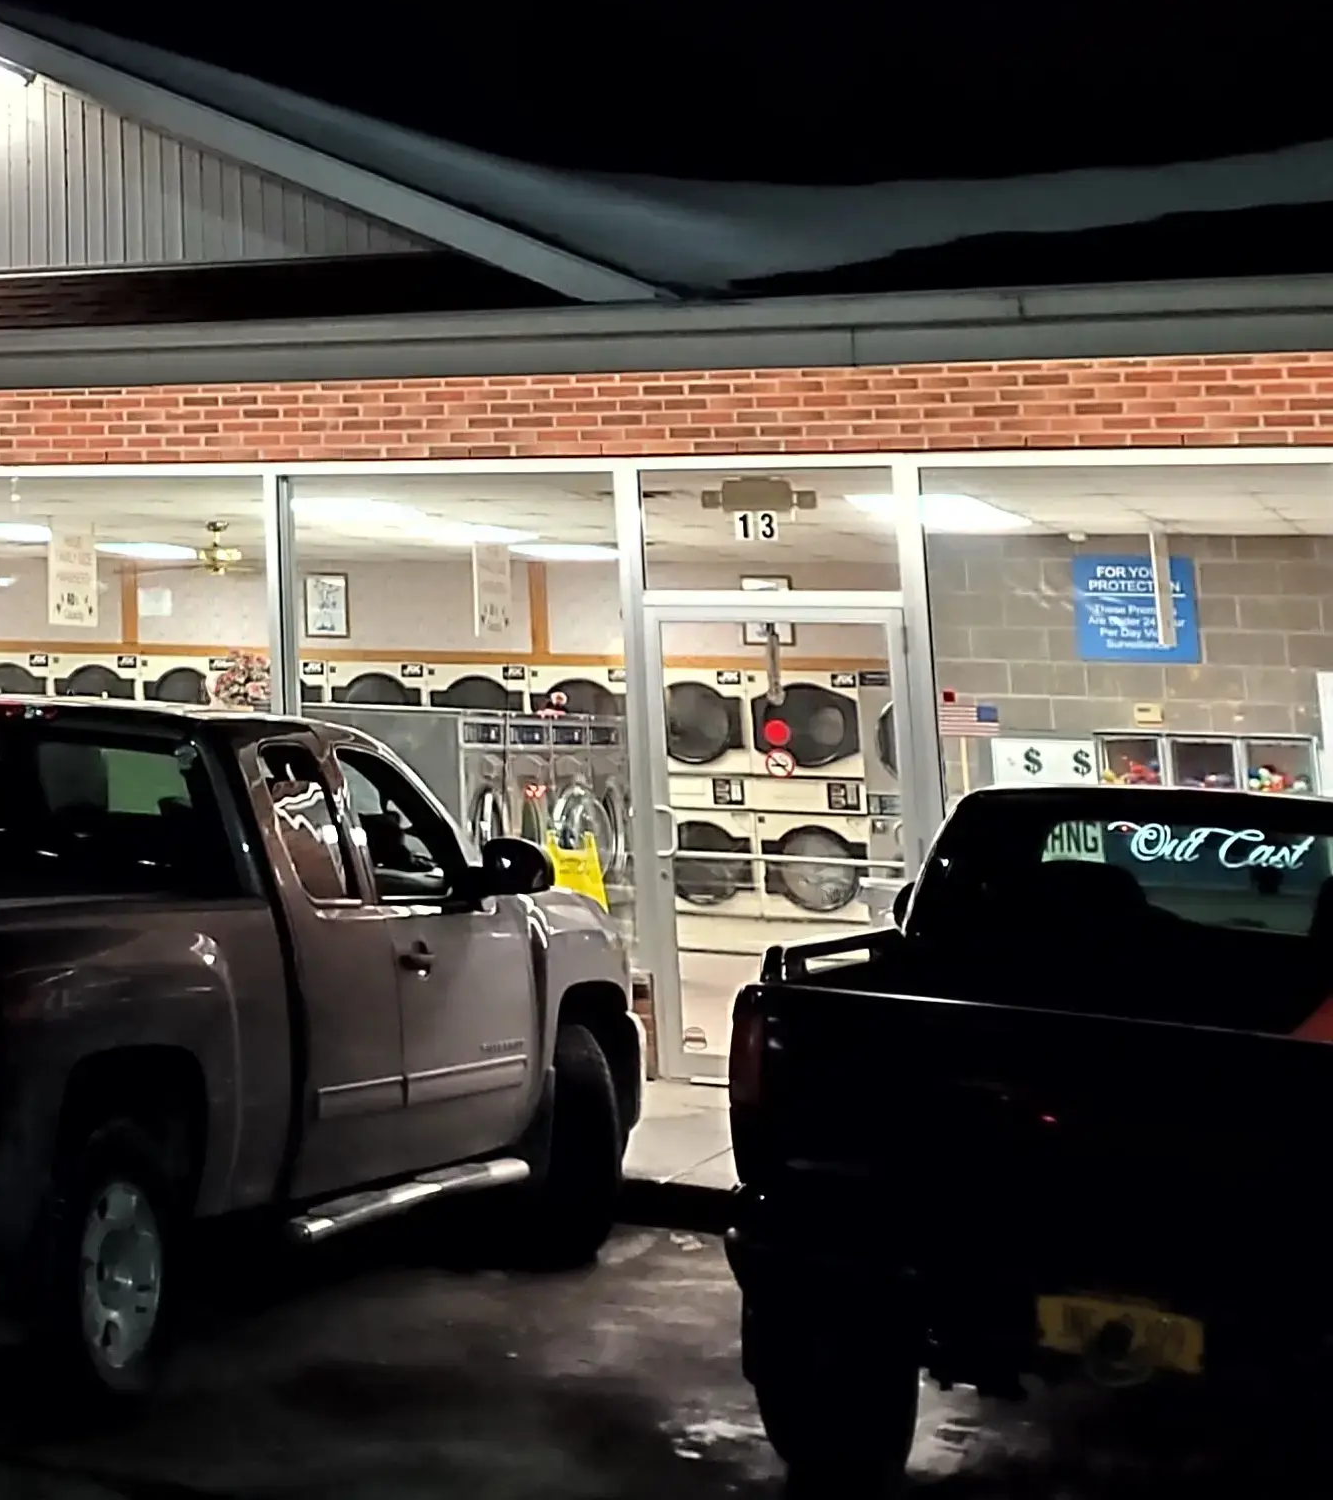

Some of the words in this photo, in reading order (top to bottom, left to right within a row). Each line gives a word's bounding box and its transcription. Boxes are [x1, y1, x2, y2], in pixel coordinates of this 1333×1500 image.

[737, 513, 775, 539] 13
[1096, 565, 1127, 579] FOR
[1088, 579, 1181, 593] PROTECTN
[1120, 627, 1142, 640] Day
